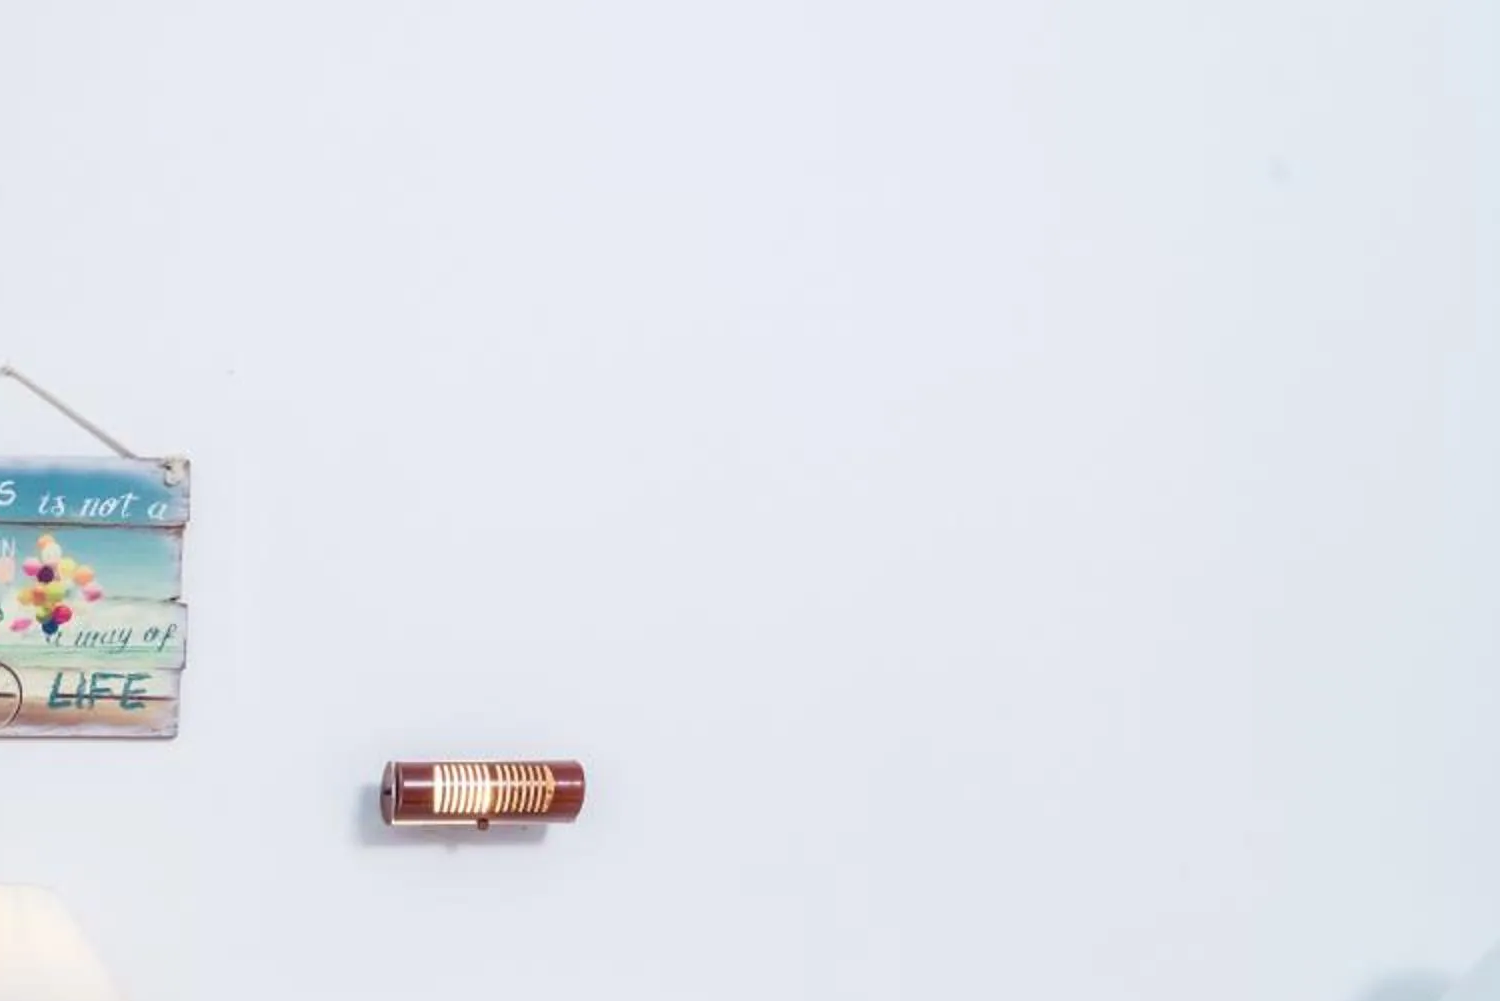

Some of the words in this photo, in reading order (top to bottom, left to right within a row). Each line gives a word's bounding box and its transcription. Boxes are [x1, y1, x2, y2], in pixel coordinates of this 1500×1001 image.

[37, 492, 64, 517] is
[78, 492, 138, 518] not
[147, 500, 169, 519] a
[143, 623, 177, 651] of
[45, 671, 152, 709] LIFE
